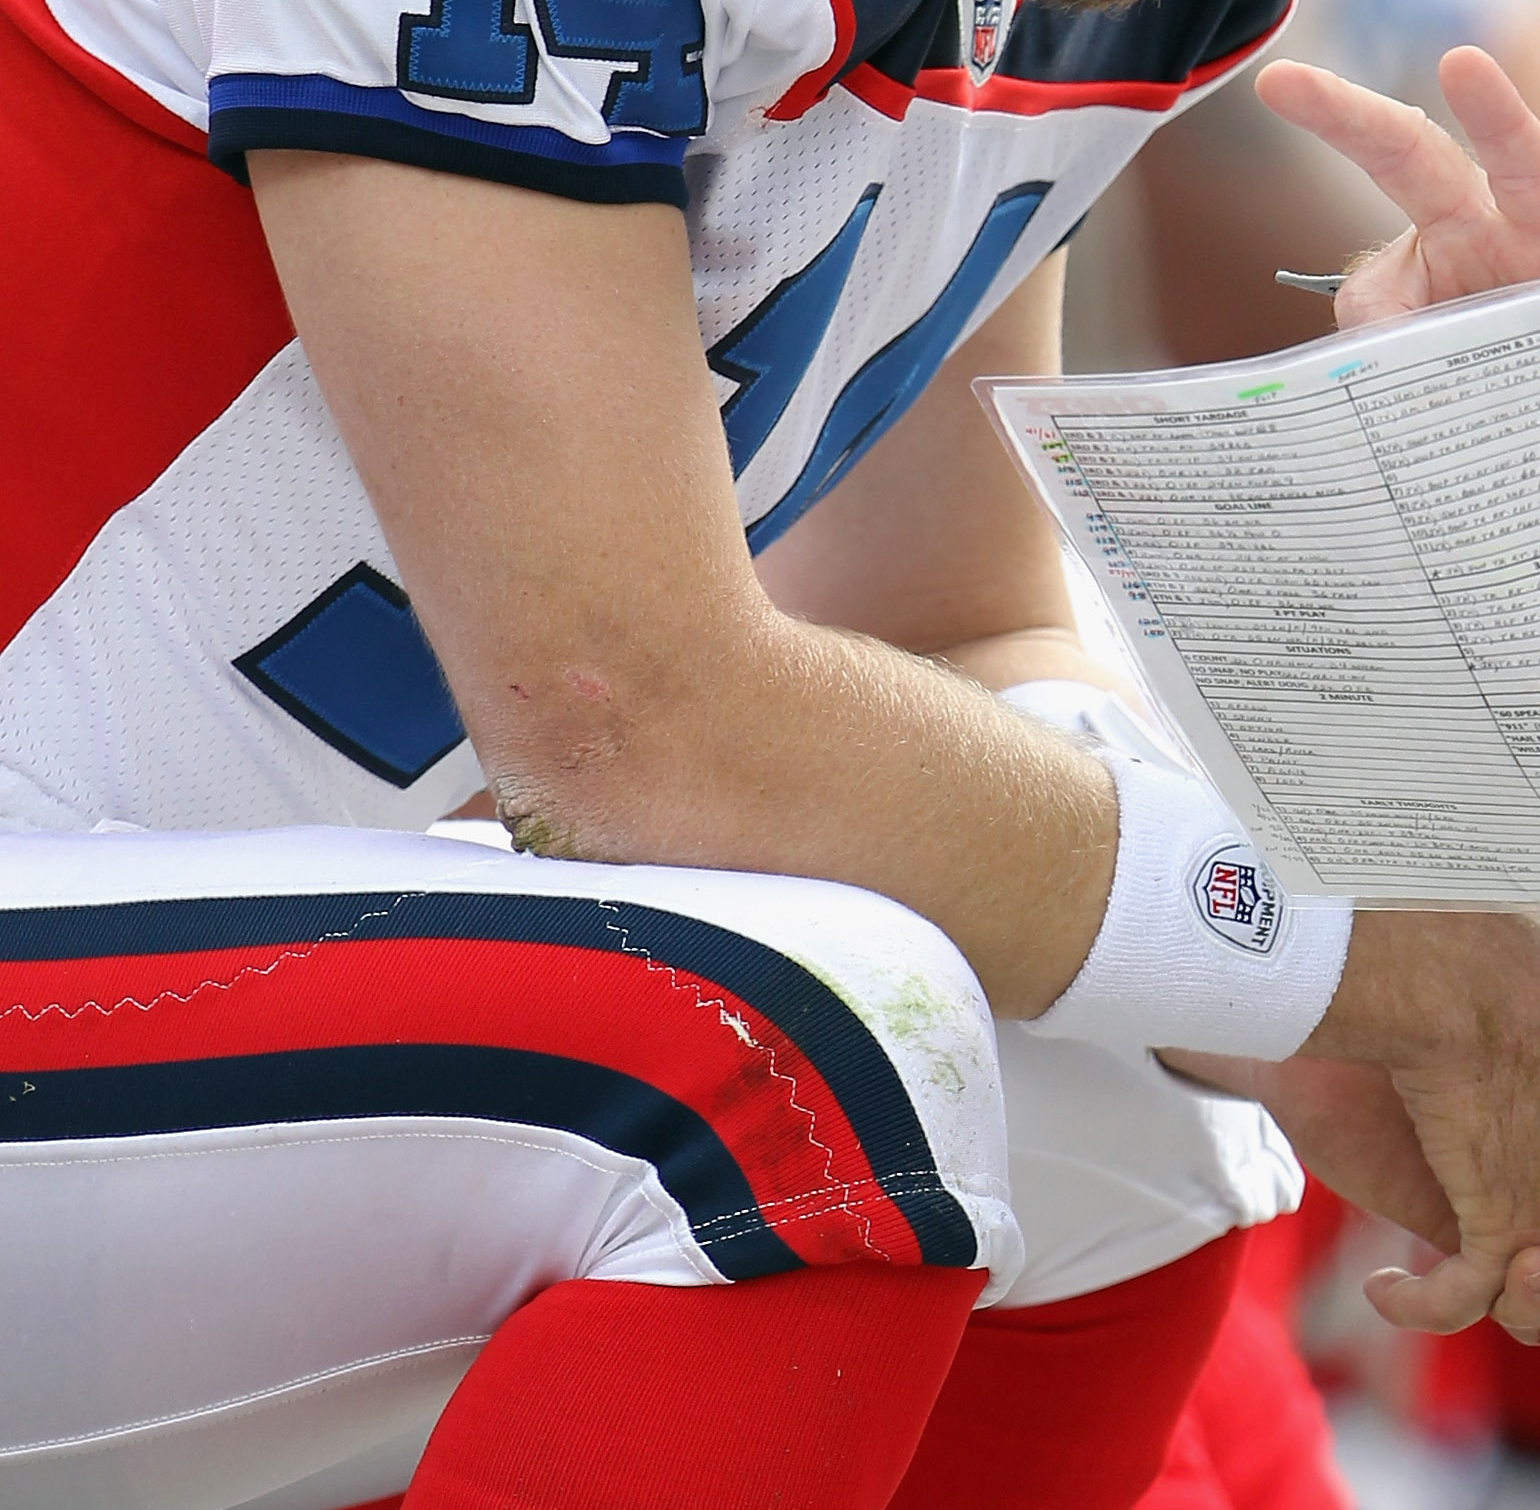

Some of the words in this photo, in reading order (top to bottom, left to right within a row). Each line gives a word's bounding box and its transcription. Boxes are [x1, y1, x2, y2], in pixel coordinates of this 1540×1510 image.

[1446, 355, 1470, 368] 3RD
[1472, 343, 1512, 362] DOWN
[1153, 414, 1191, 425] SHORT
[1193, 410, 1248, 423] YARDAGE
[1214, 502, 1246, 511] GOAL
[1249, 501, 1273, 510] LINE
[1299, 610, 1327, 618] PLAY
[1286, 645, 1352, 655] SITUATIONS
[1193, 654, 1228, 663] COUNT
[1240, 668, 1256, 676] NO
[1257, 669, 1281, 678] PLAY
[1278, 680, 1309, 689] DOUG
[1329, 693, 1375, 703] MINUTE
[1360, 799, 1397, 807] EARLY
[1398, 800, 1458, 811] THOUGHTS
[1211, 867, 1237, 913] NFL
